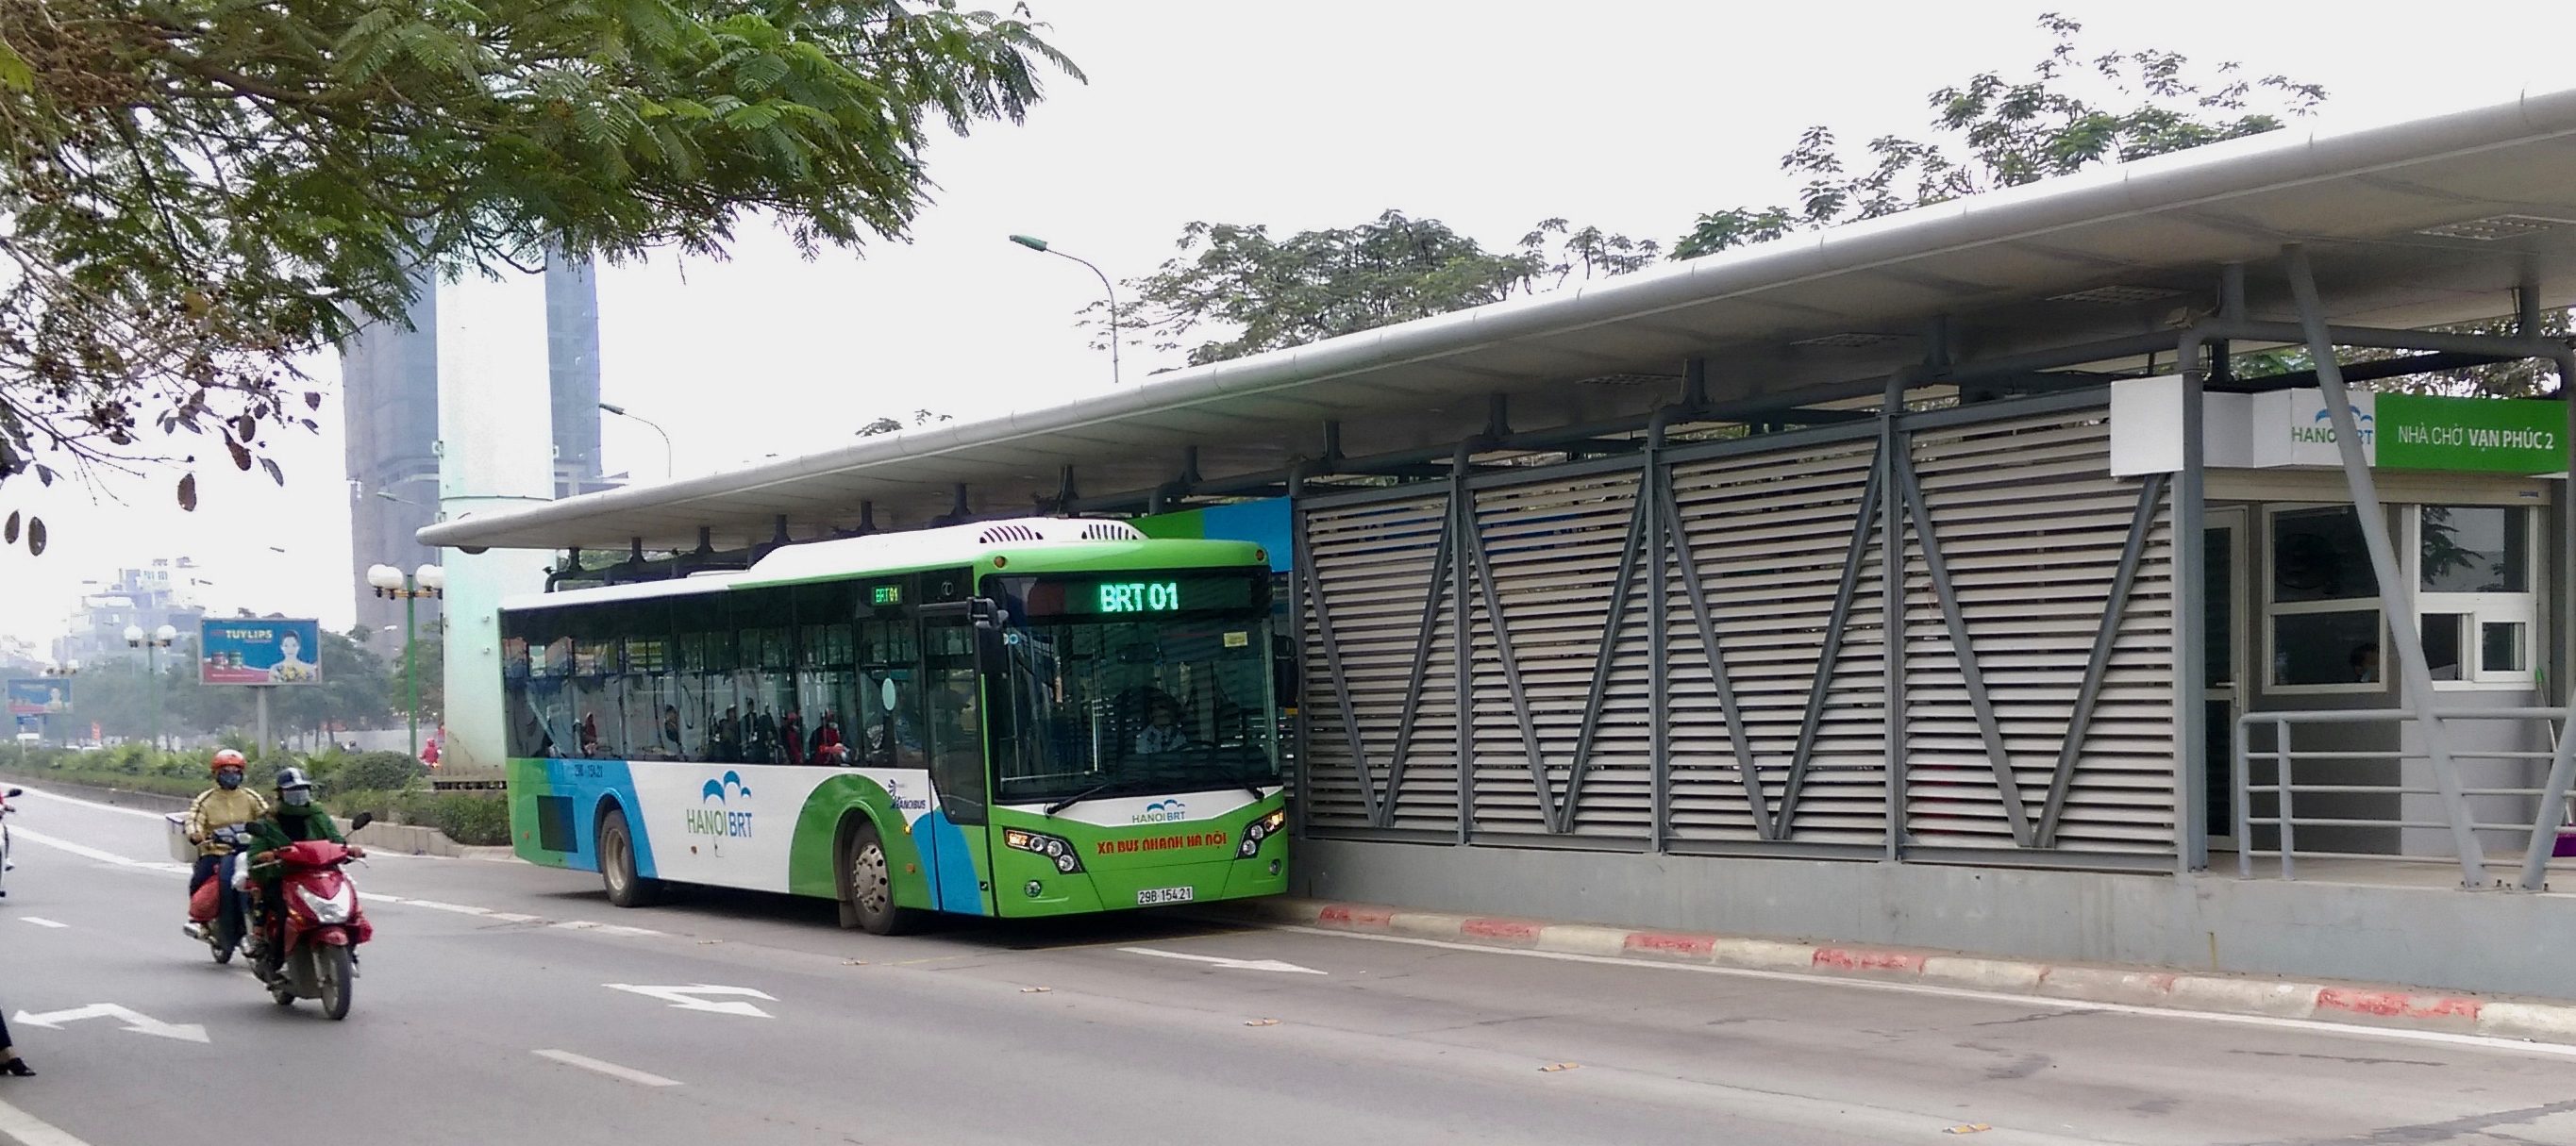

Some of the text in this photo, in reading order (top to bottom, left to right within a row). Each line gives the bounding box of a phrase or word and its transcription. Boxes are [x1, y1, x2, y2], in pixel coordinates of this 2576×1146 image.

[2399, 423, 2429, 444] NHÀ
[2468, 428, 2499, 452] VẠN
[2502, 427, 2542, 449] PHÚC
[2545, 433, 2553, 450] 2
[1101, 582, 1179, 612] BRT 01
[226, 629, 273, 639] TUYLIPS
[1117, 839, 1139, 853] BUS
[1143, 836, 1183, 852] NHANH
